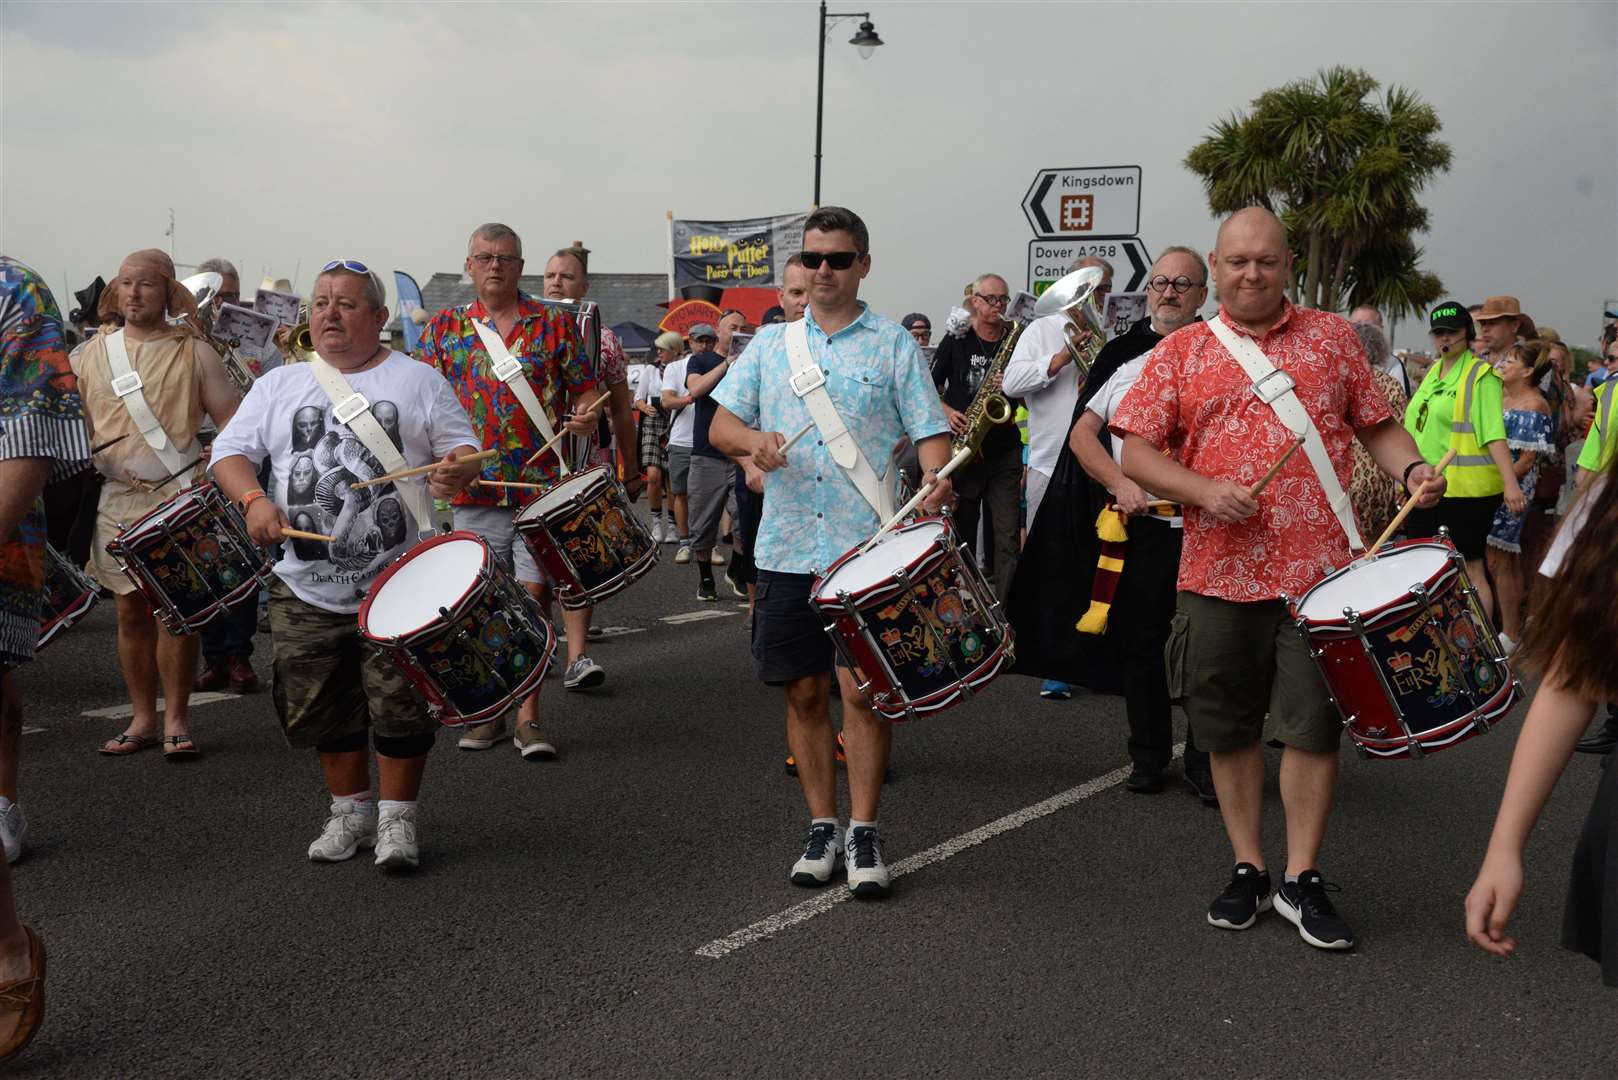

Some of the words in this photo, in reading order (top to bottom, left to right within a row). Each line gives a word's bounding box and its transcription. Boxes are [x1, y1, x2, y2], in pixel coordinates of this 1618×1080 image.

[1062, 175, 1134, 189] Kingsdown
[727, 244, 769, 268] Putter
[1035, 247, 1073, 258] Dover
[732, 264, 744, 279] of
[747, 264, 769, 278] Doom
[312, 572, 350, 584] DEATH
